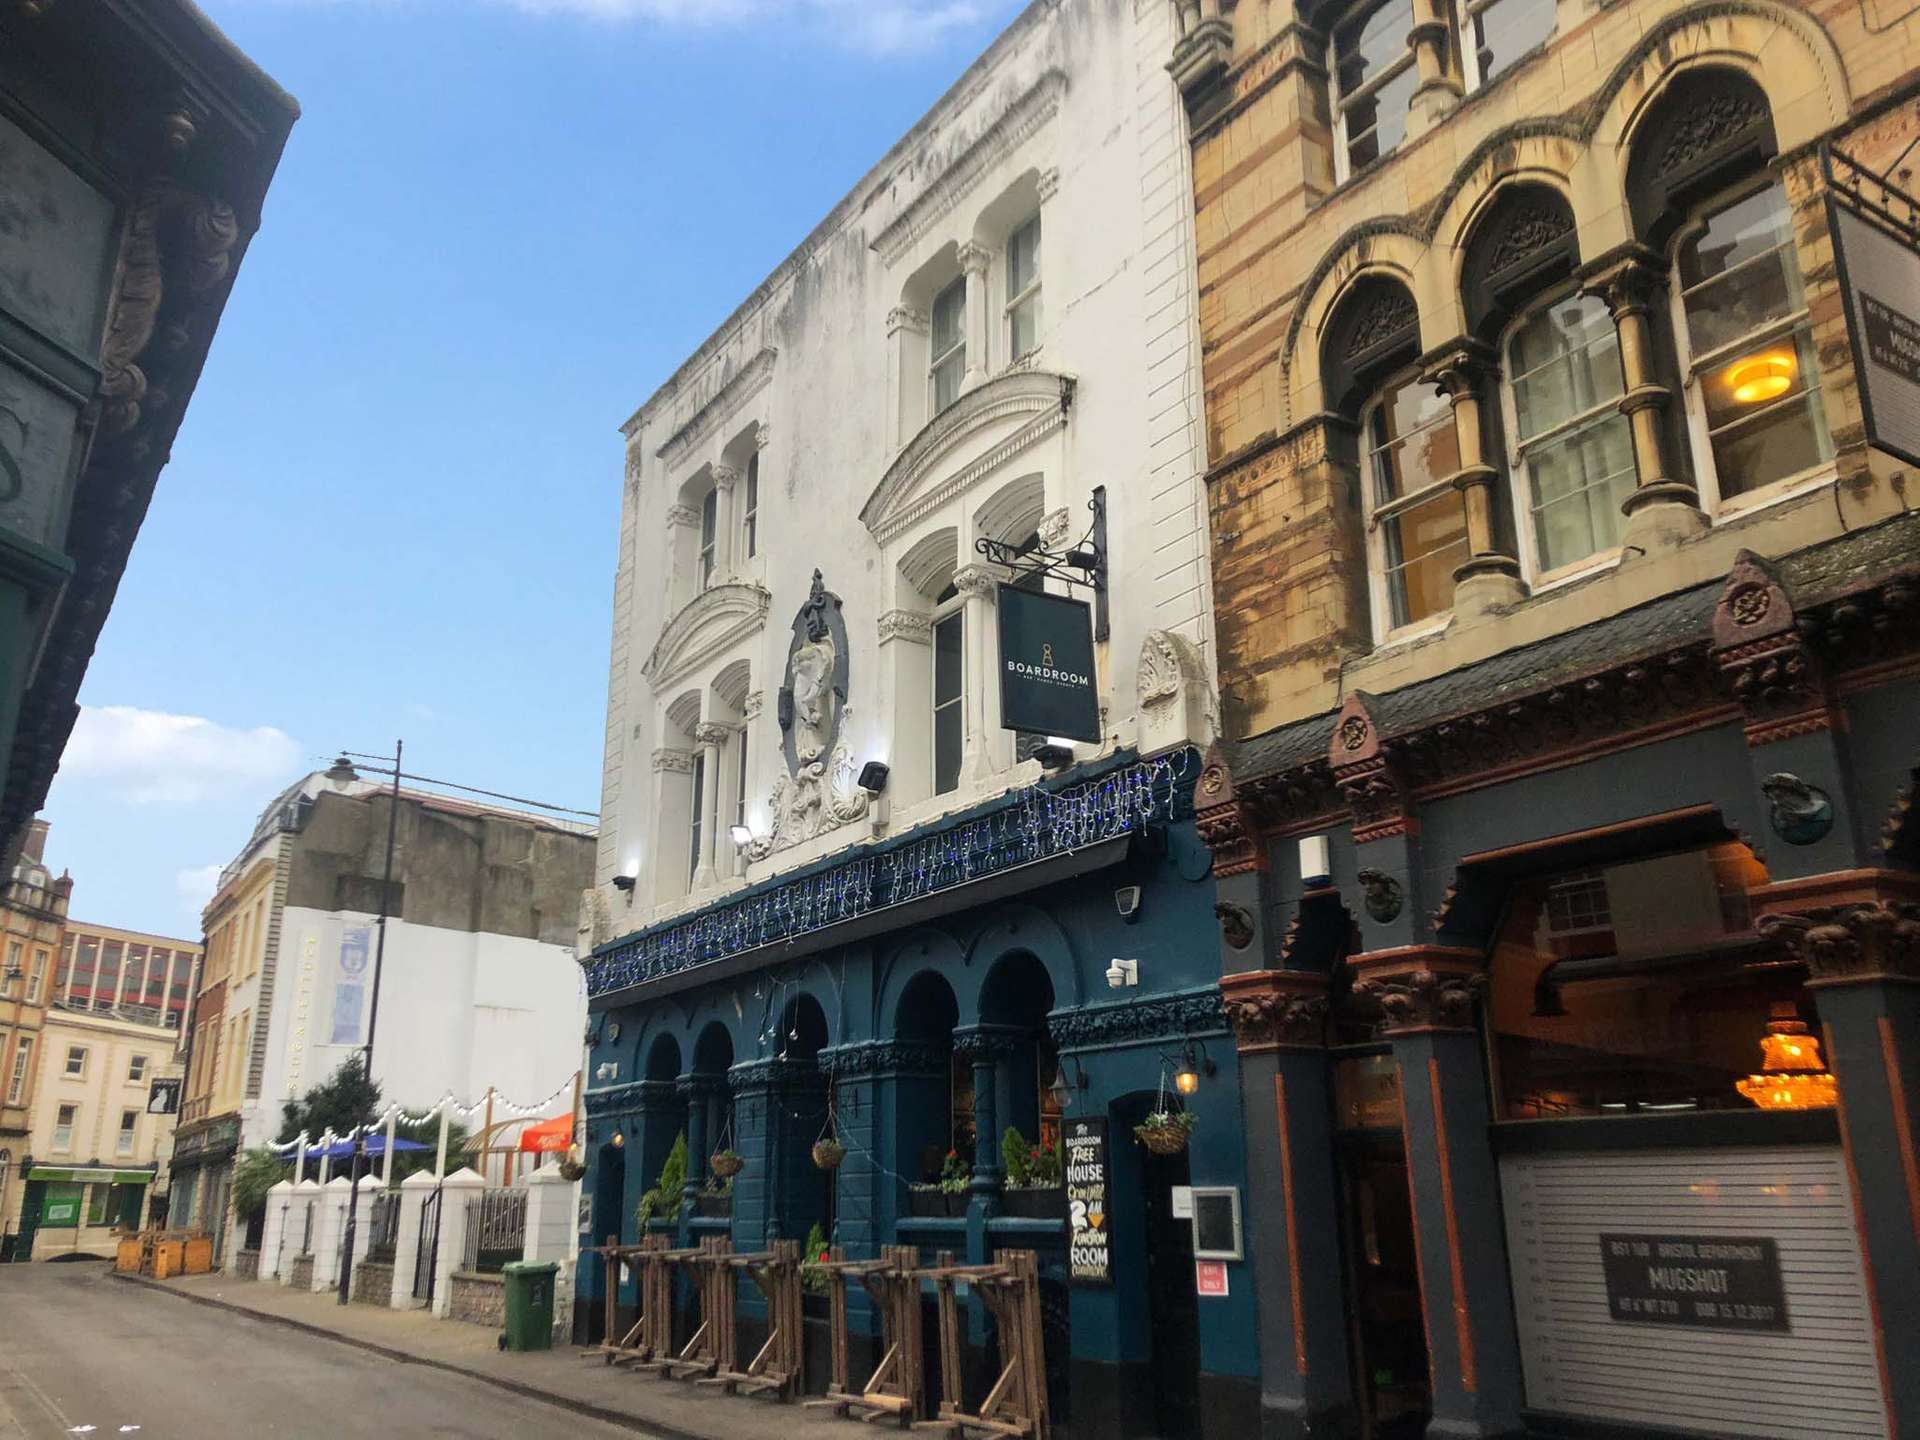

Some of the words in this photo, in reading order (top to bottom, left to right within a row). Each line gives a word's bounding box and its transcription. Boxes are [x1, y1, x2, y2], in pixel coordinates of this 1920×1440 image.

[1007, 661, 1089, 686] BOARDROOM
[1066, 1164, 1104, 1183] HOUSE
[1070, 1200, 1088, 1228] 2
[1070, 1247, 1109, 1266] ROOM
[1648, 1266, 1729, 1295] MUGSHOT
